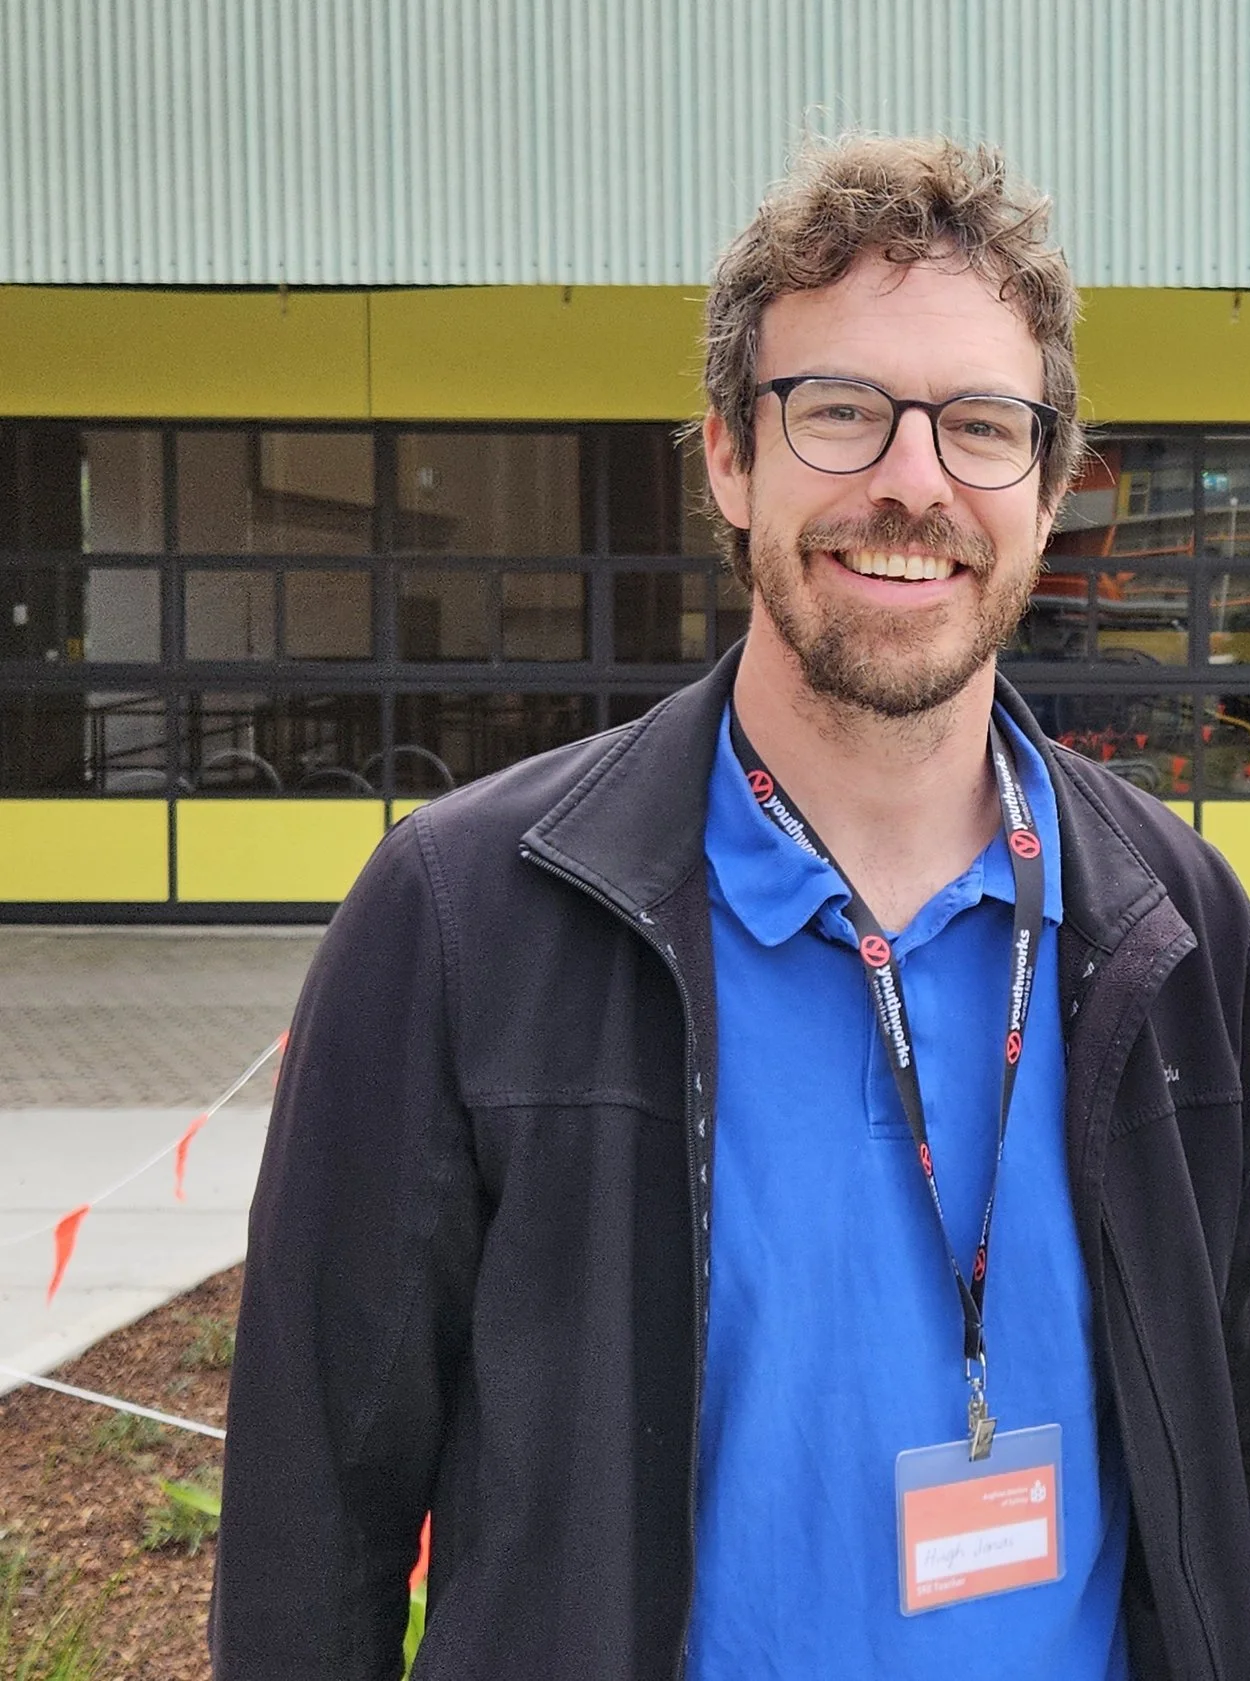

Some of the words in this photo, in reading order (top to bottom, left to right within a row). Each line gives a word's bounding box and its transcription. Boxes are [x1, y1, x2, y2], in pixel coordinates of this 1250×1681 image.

[764, 795, 829, 864] youthwo
[997, 752, 1028, 830] youthworks
[876, 964, 910, 1069] youthworks
[1011, 929, 1030, 1031] youthworks
